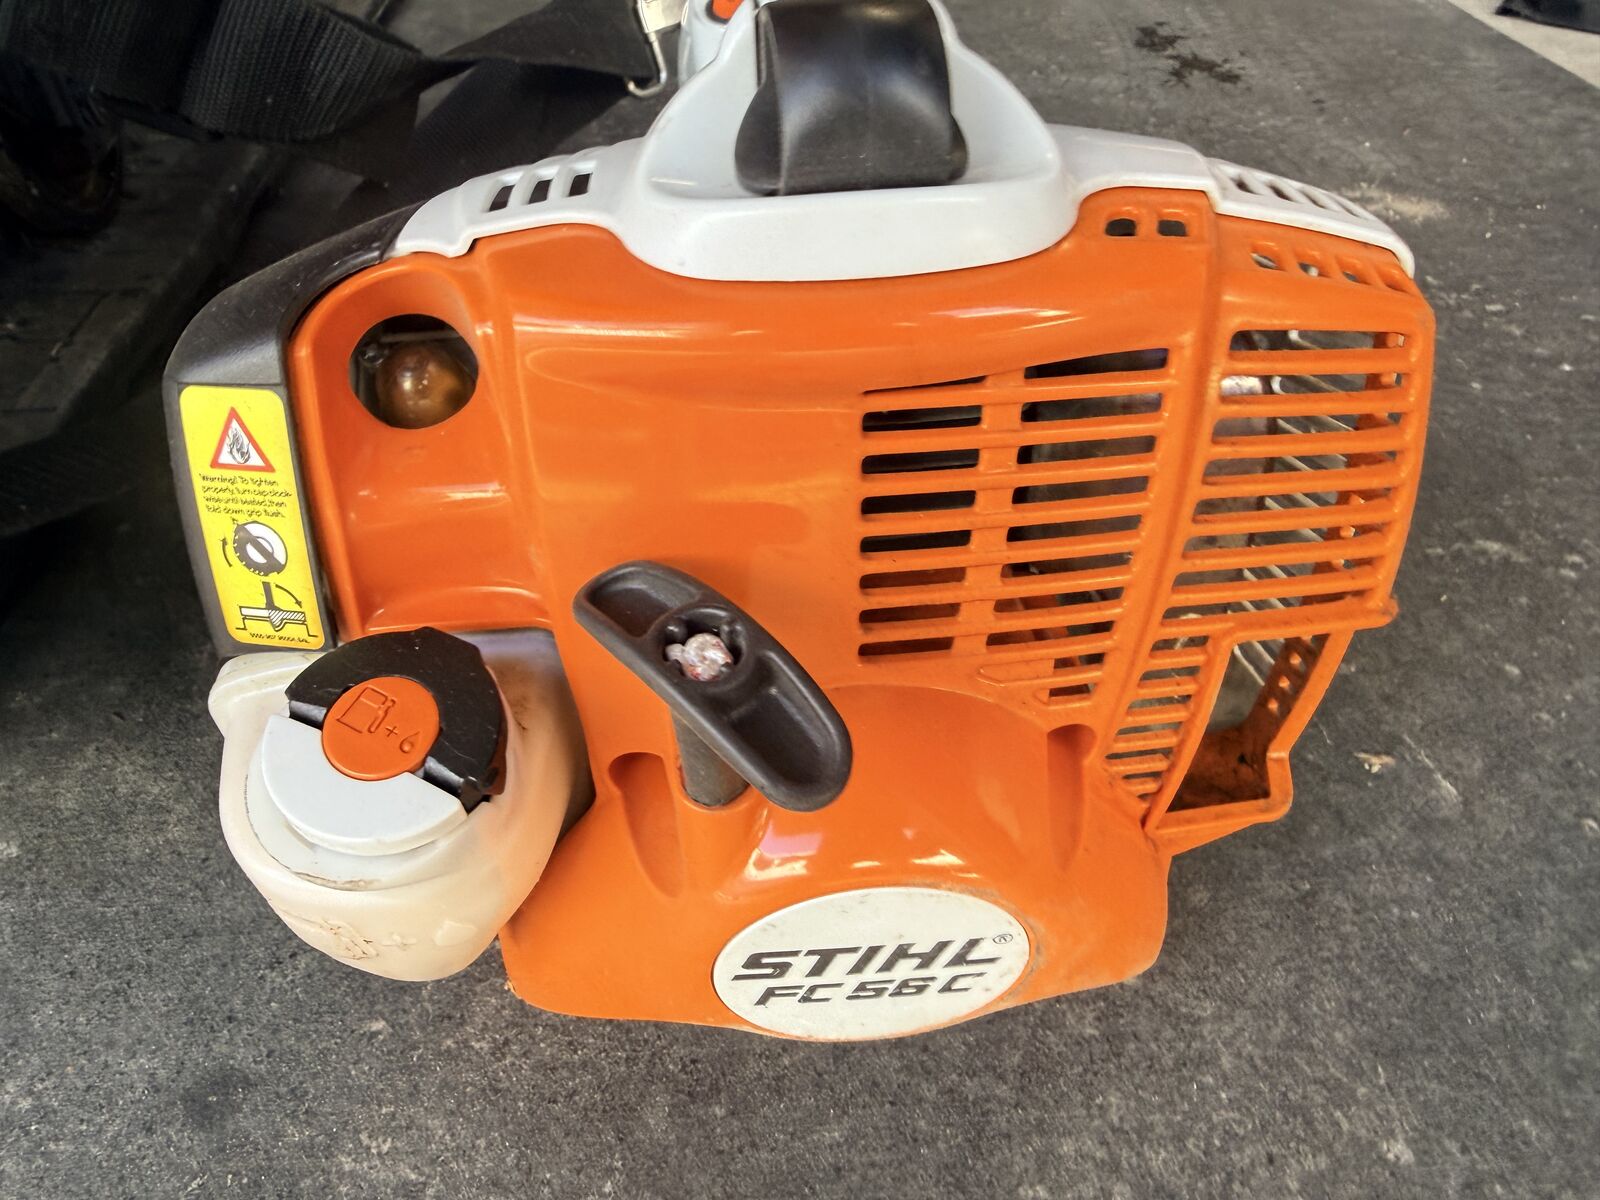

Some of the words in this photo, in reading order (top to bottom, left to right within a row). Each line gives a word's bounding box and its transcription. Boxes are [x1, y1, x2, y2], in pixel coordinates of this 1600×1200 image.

[754, 983, 844, 1006] FC
[846, 977, 937, 1000] 56
[938, 972, 987, 994] C
